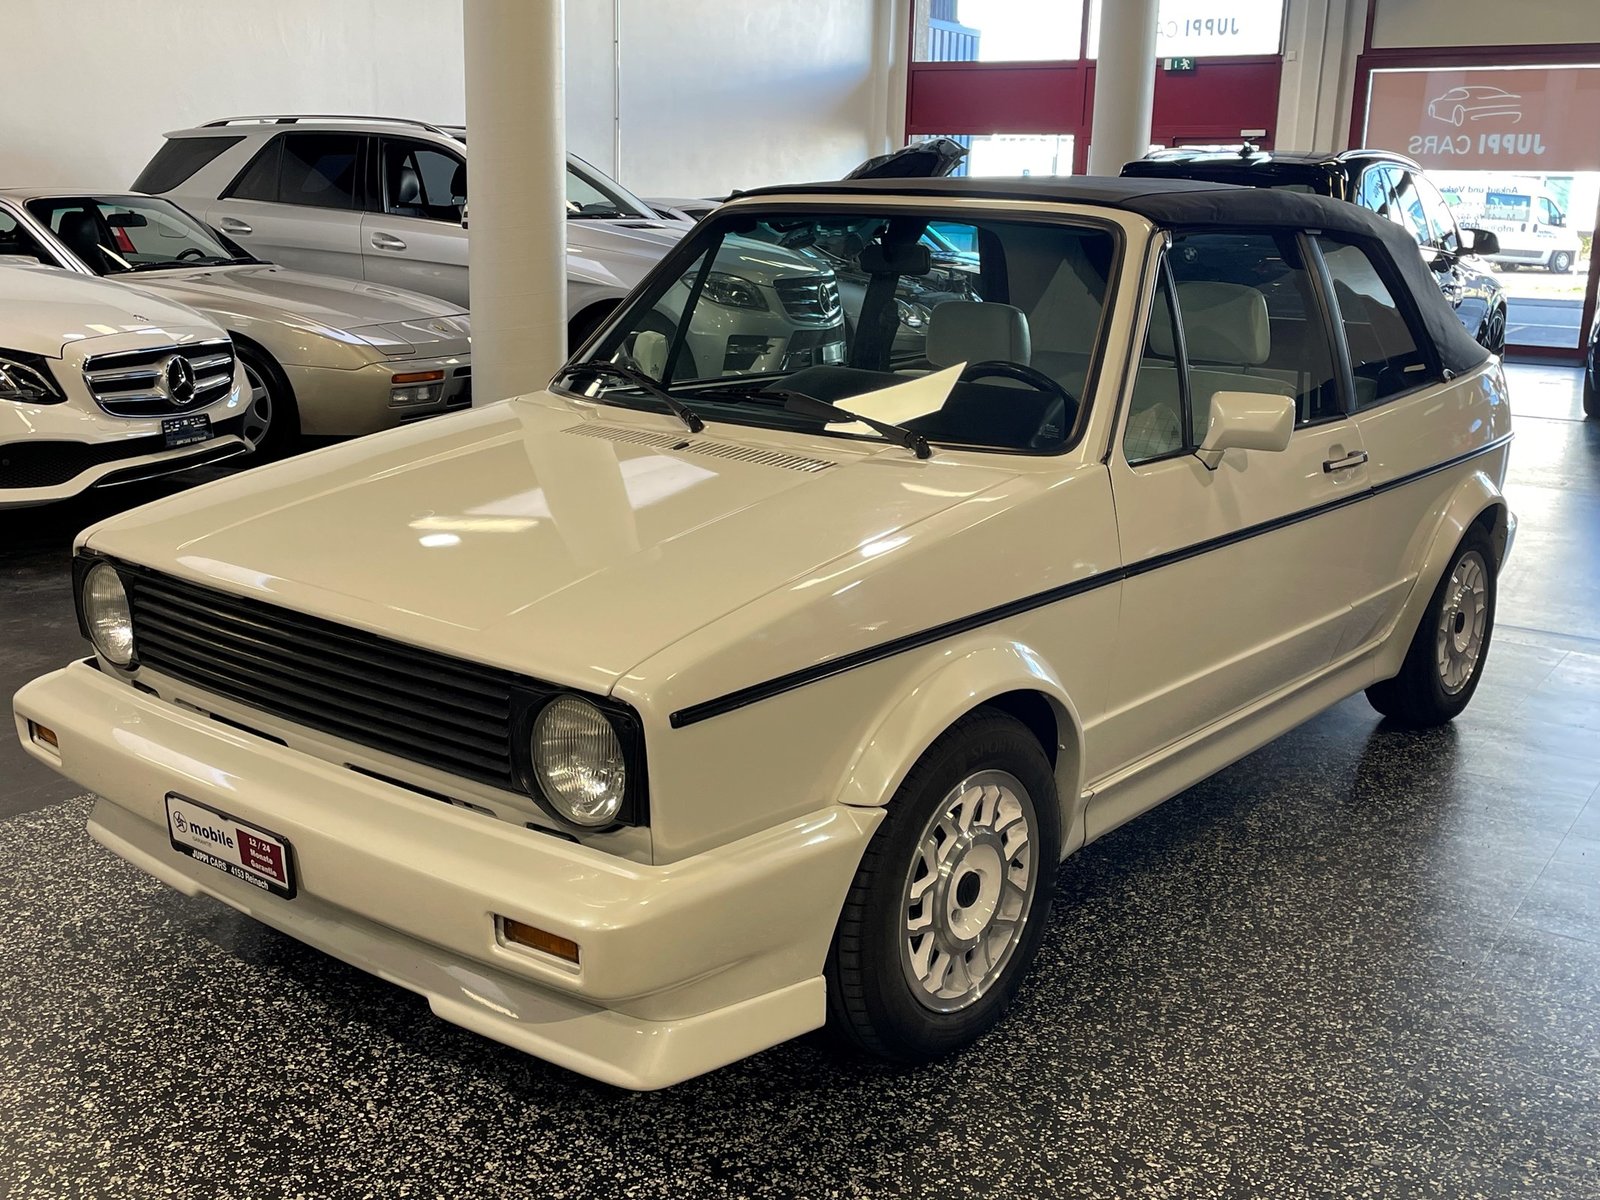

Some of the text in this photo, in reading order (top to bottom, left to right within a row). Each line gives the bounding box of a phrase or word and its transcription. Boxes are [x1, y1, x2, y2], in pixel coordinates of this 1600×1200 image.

[189, 821, 234, 849] mobile
[248, 837, 257, 847] 12
[262, 843, 271, 853] 24
[249, 848, 274, 865] Monate
[192, 849, 269, 891] JUPPI CARS 4153 Reinach
[250, 859, 278, 877] Garantie
